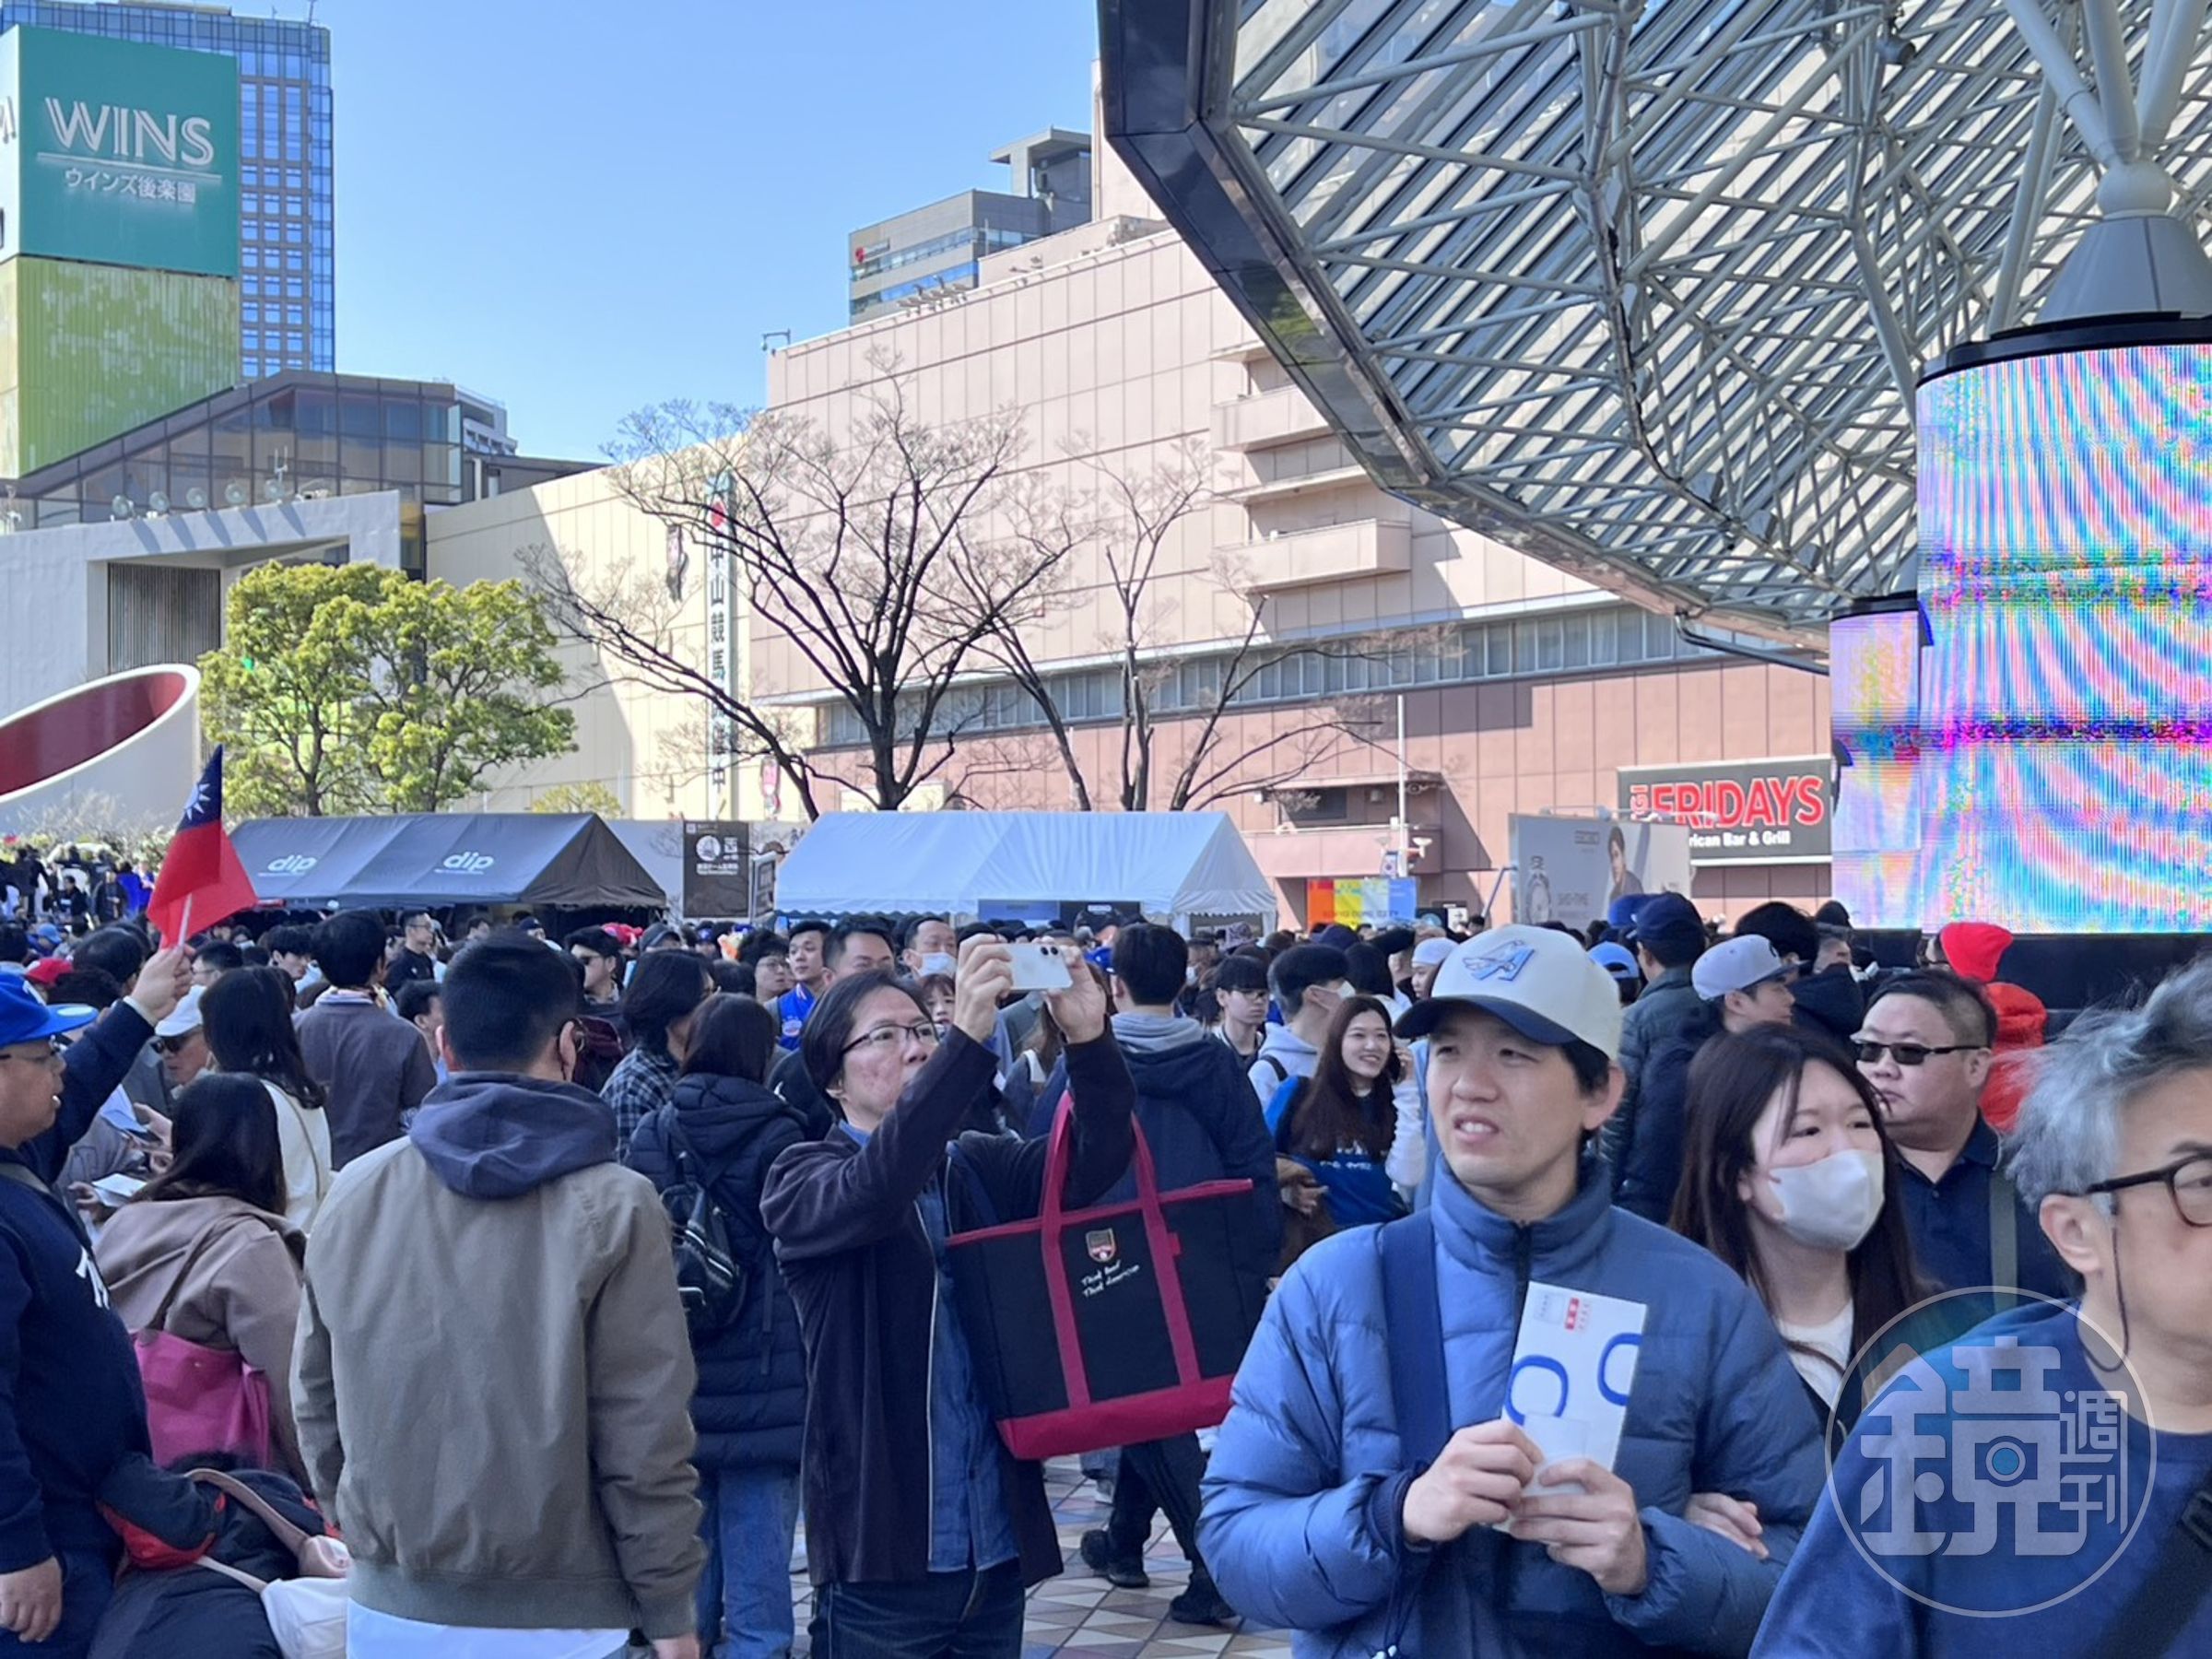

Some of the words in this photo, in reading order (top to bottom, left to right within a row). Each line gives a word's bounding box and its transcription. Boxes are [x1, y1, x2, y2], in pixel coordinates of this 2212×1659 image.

[45, 97, 215, 166] WINS
[65, 167, 195, 204] ウインズ後楽園
[1630, 783, 1649, 821] GI
[1651, 775, 1825, 830] FRIDAYS
[1688, 833, 1721, 847] rican
[1723, 831, 1746, 847] Bar
[1747, 830, 1760, 846] &
[1762, 830, 1792, 845] Grill
[267, 853, 318, 875] dip
[442, 851, 495, 873] dip
